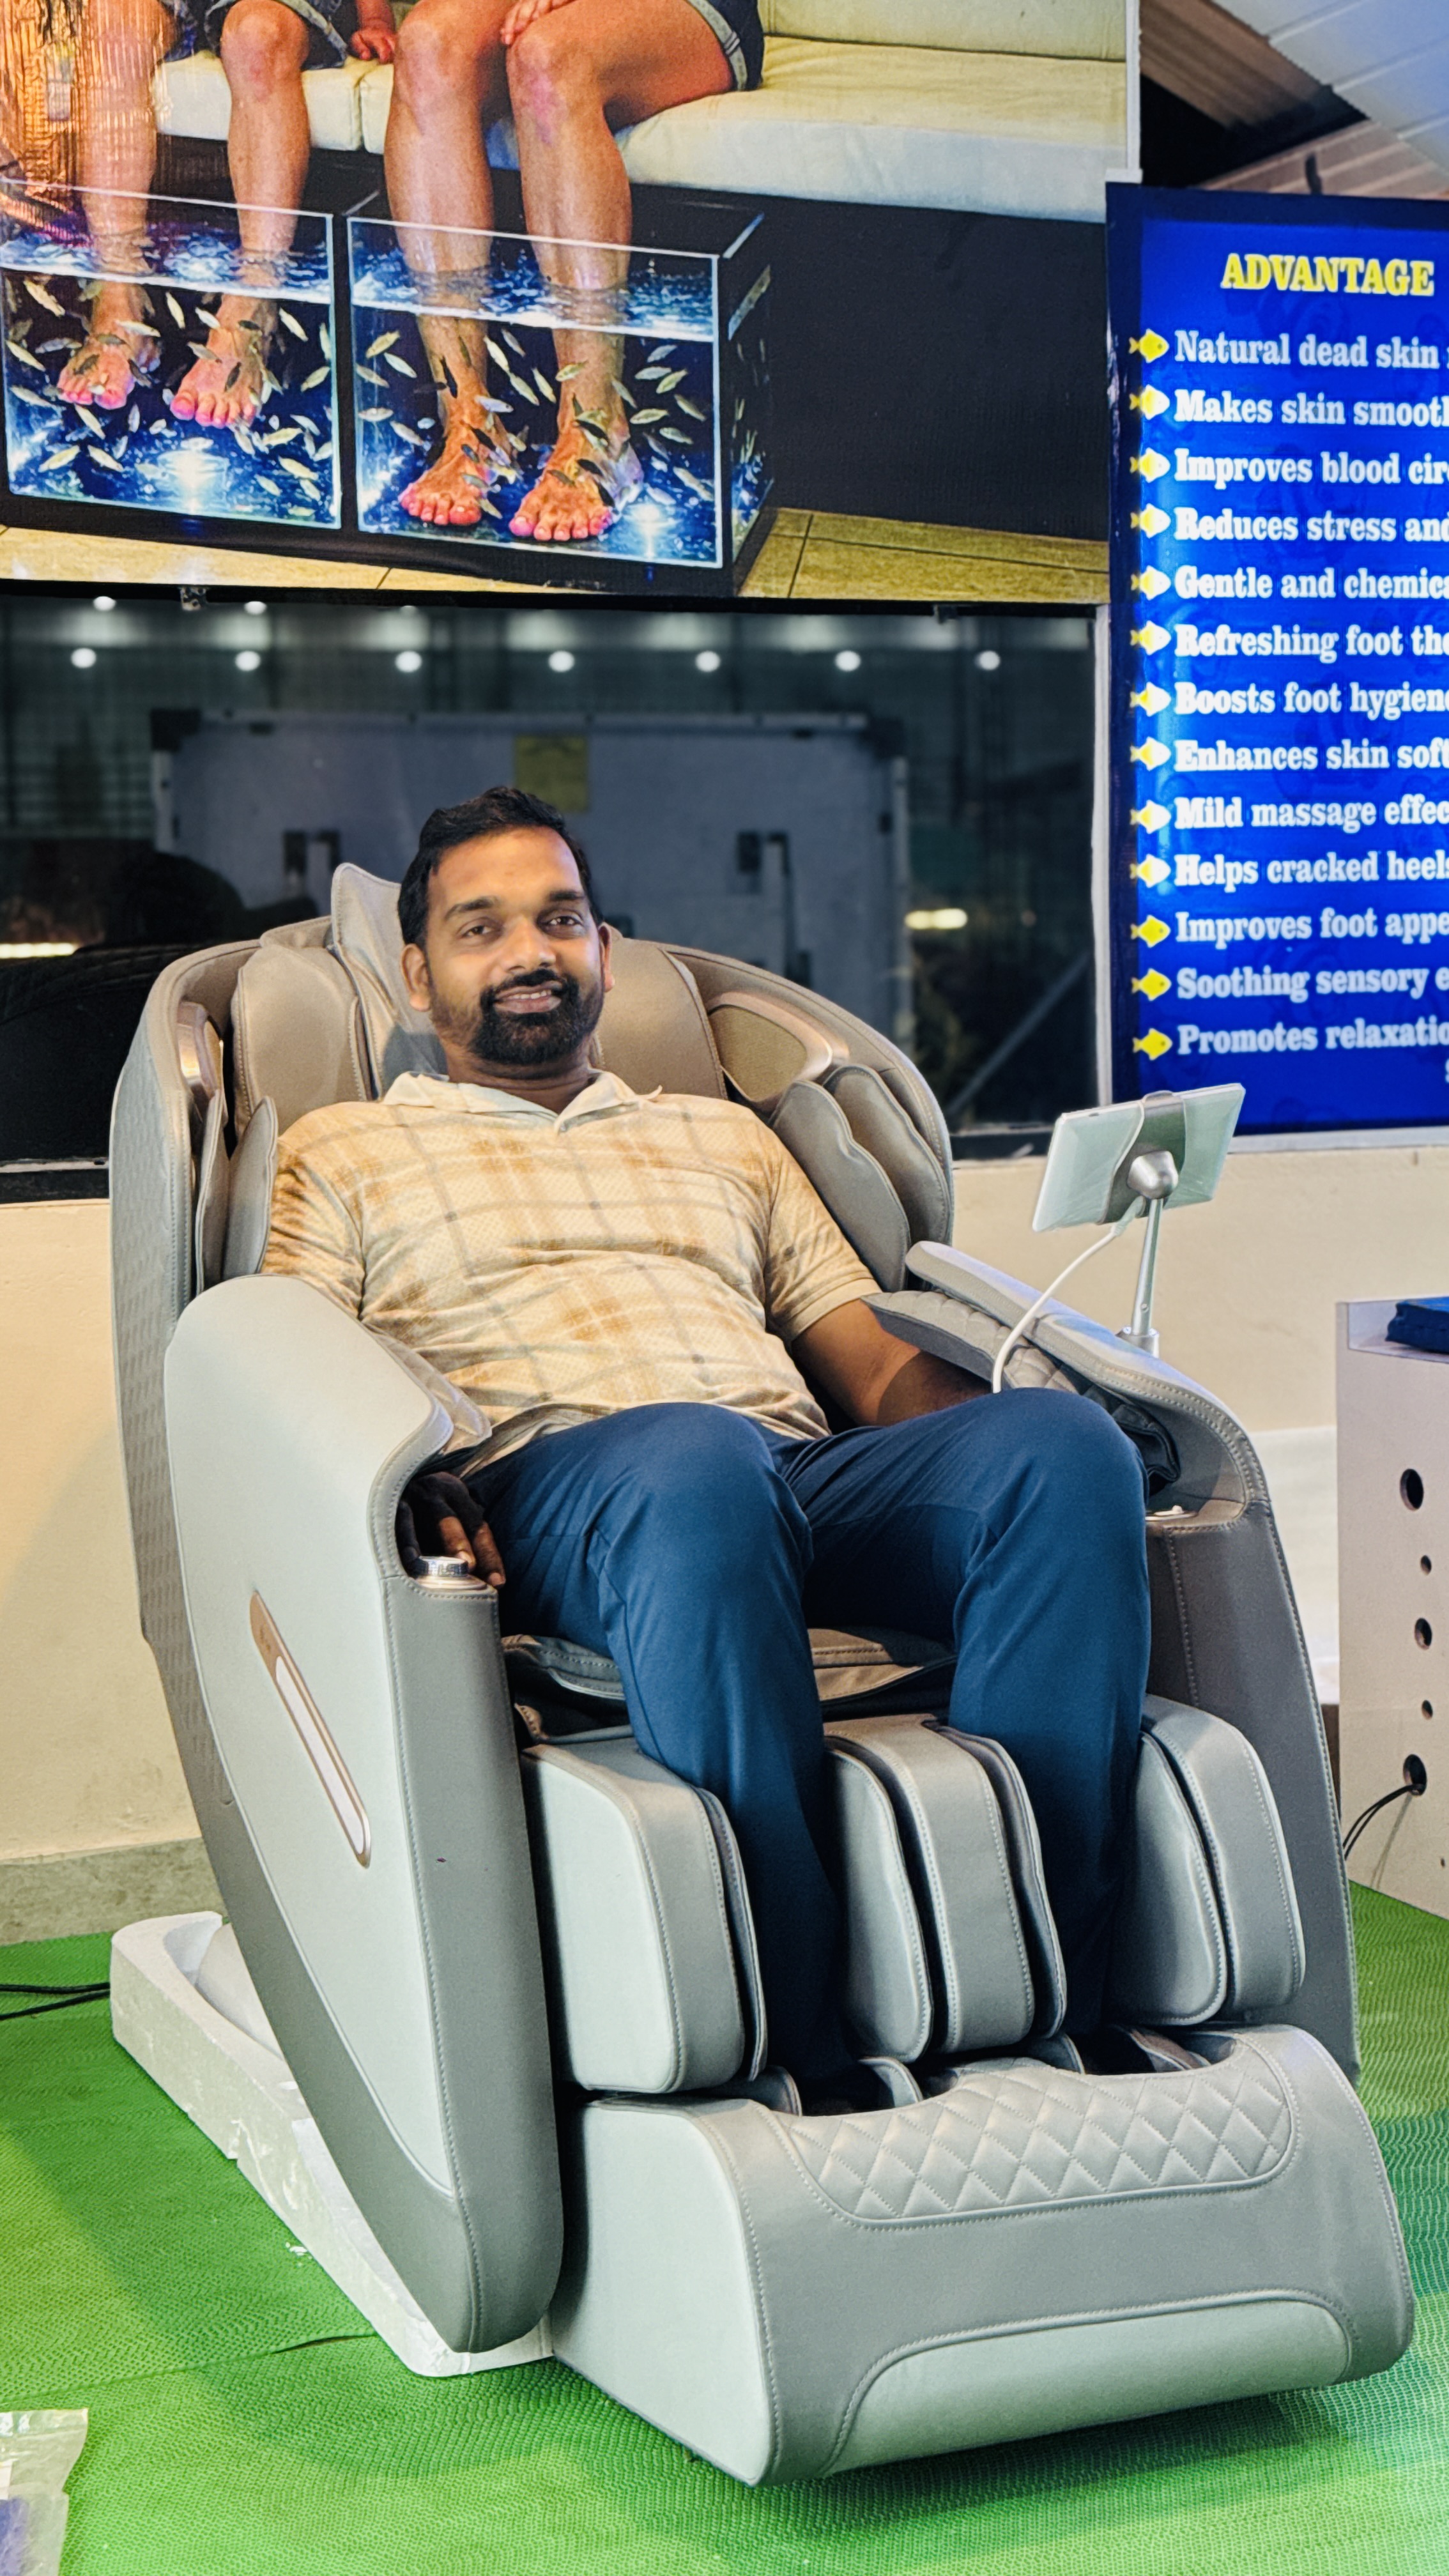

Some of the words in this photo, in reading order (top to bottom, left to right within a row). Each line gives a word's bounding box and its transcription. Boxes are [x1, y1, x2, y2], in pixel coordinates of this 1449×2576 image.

[1220, 253, 1434, 296] ADVANTAGE
[1175, 330, 1290, 364] Natural
[1300, 335, 1368, 366] dead
[1377, 337, 1439, 369] skin
[1174, 389, 1273, 423] Makes
[1282, 393, 1346, 424] skin
[1174, 448, 1312, 489] Improves
[1321, 452, 1400, 484] blood
[1409, 453, 1449, 484] cir
[1174, 507, 1298, 540] Reduces
[1307, 510, 1396, 541] stress
[1174, 565, 1272, 599] Gentle
[1281, 568, 1335, 598] and
[1174, 624, 1339, 663] Refreshing
[1346, 625, 1403, 655] foot
[1174, 682, 1275, 714] Boosts
[1284, 682, 1341, 712] foot
[1174, 740, 1317, 772] Enhances
[1326, 739, 1390, 769] skin
[1174, 797, 1243, 829] Mild
[1252, 802, 1376, 833] massage
[1174, 854, 1258, 893] Helps
[1268, 851, 1379, 883] cracked
[1387, 850, 1449, 880] heel
[1176, 912, 1312, 949] Improves
[1321, 908, 1377, 937] foot
[1177, 965, 1310, 1002] Soothing
[1316, 969, 1429, 999] sensory
[1178, 1023, 1317, 1054] Promotes
